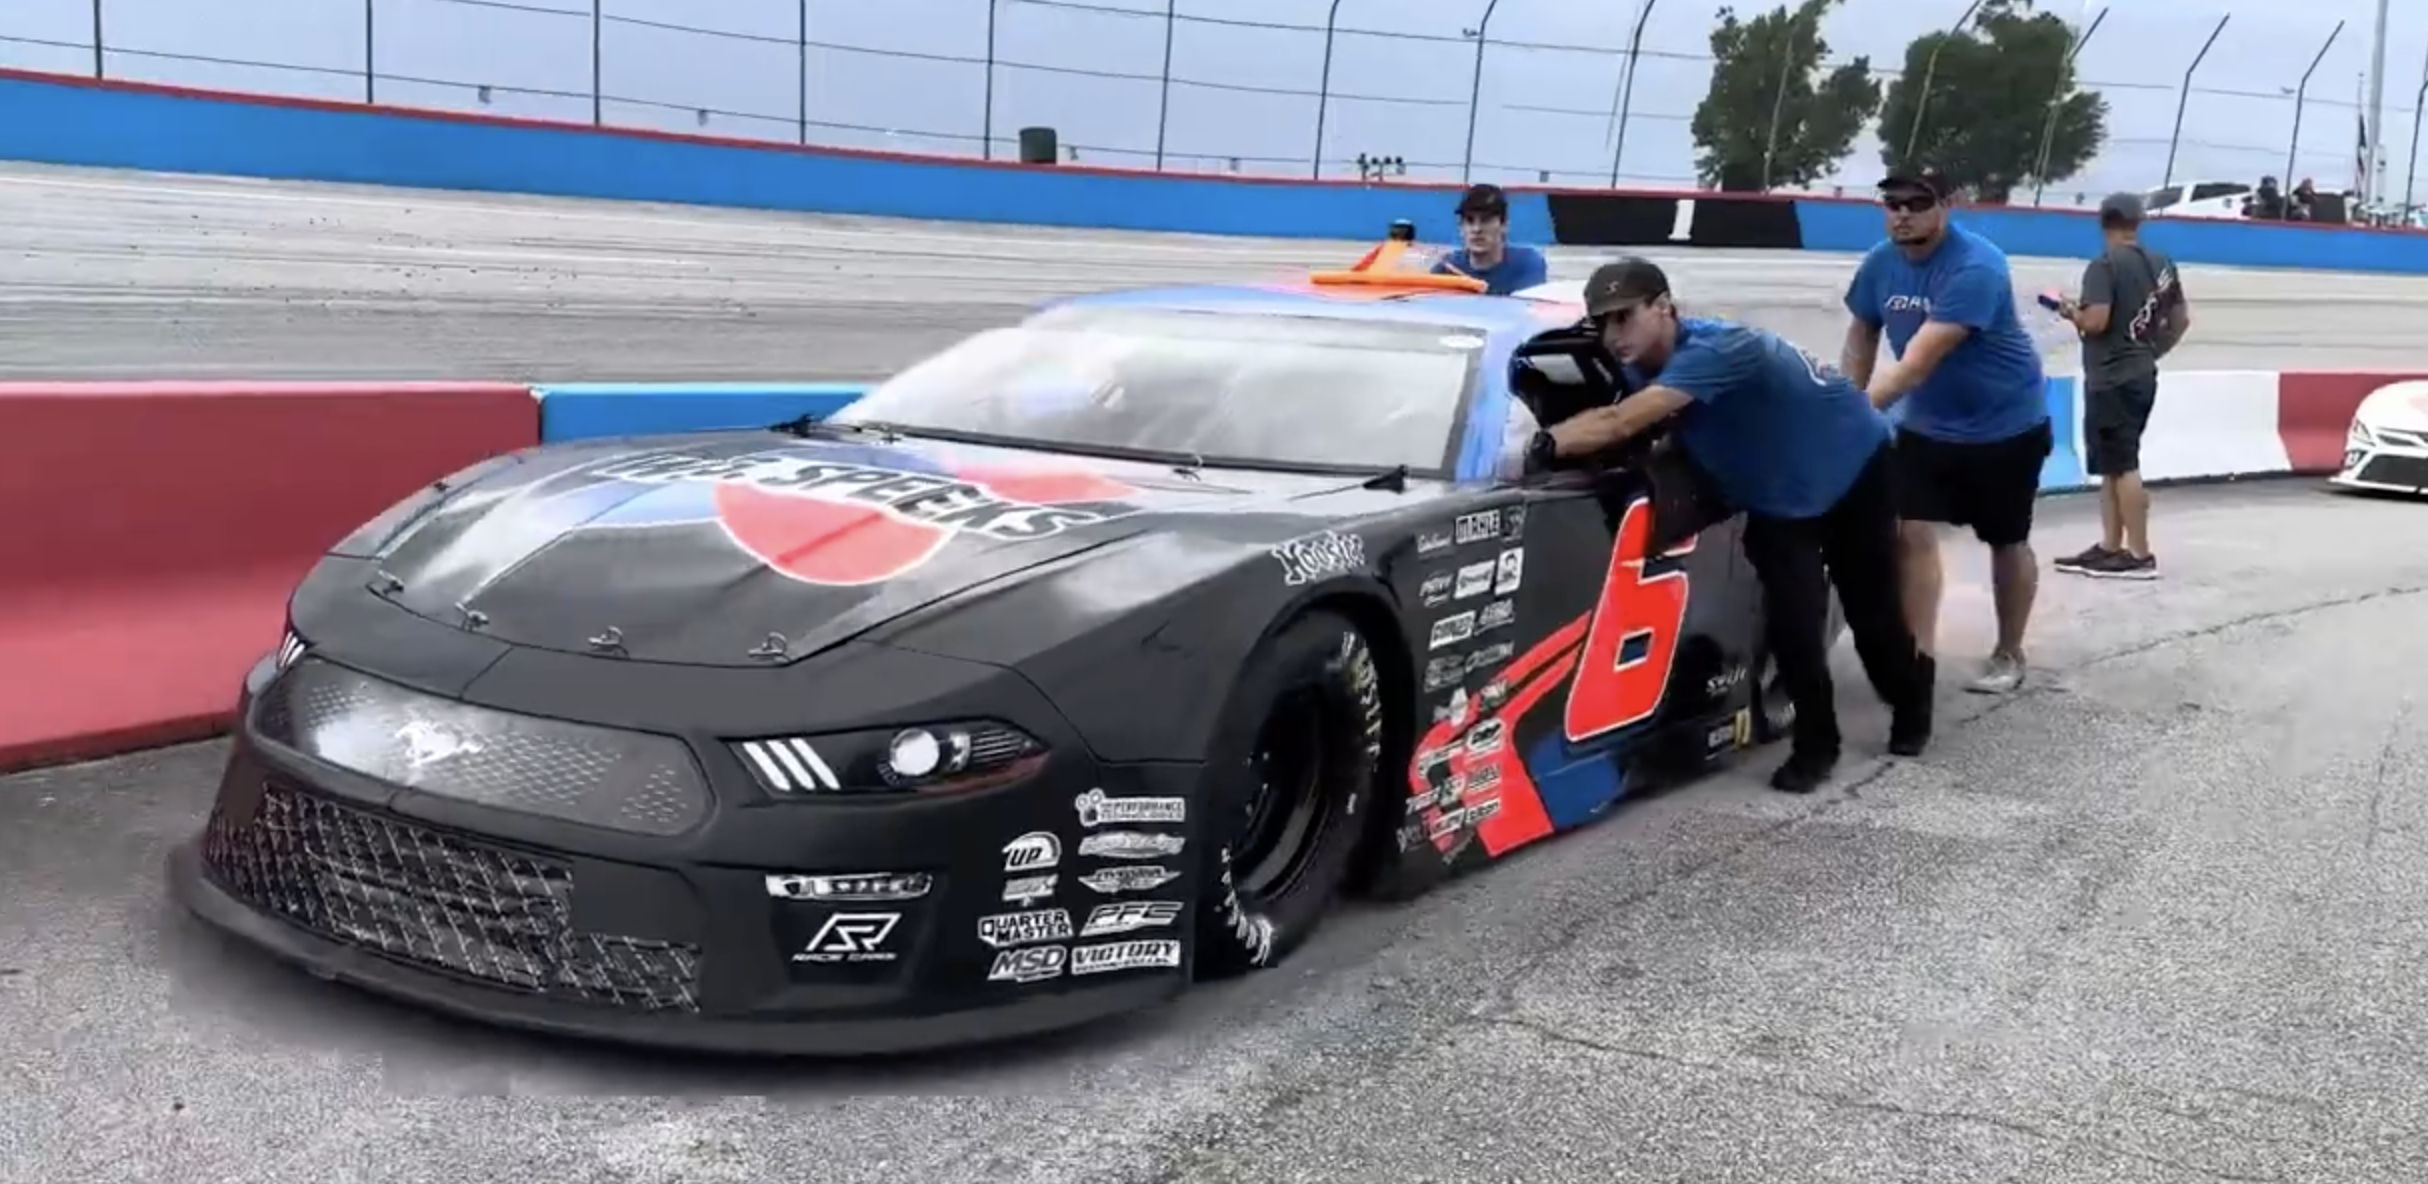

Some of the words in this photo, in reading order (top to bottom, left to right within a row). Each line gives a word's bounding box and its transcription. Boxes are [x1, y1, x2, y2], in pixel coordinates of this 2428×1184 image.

[1668, 199, 1695, 240] 1
[1565, 497, 1698, 742] 6
[1010, 847, 1043, 866] UP
[981, 910, 1065, 939] QUARTER
[996, 924, 1071, 944] MASTER
[991, 945, 1067, 977] MSD
[1073, 941, 1175, 964] VICTORY
